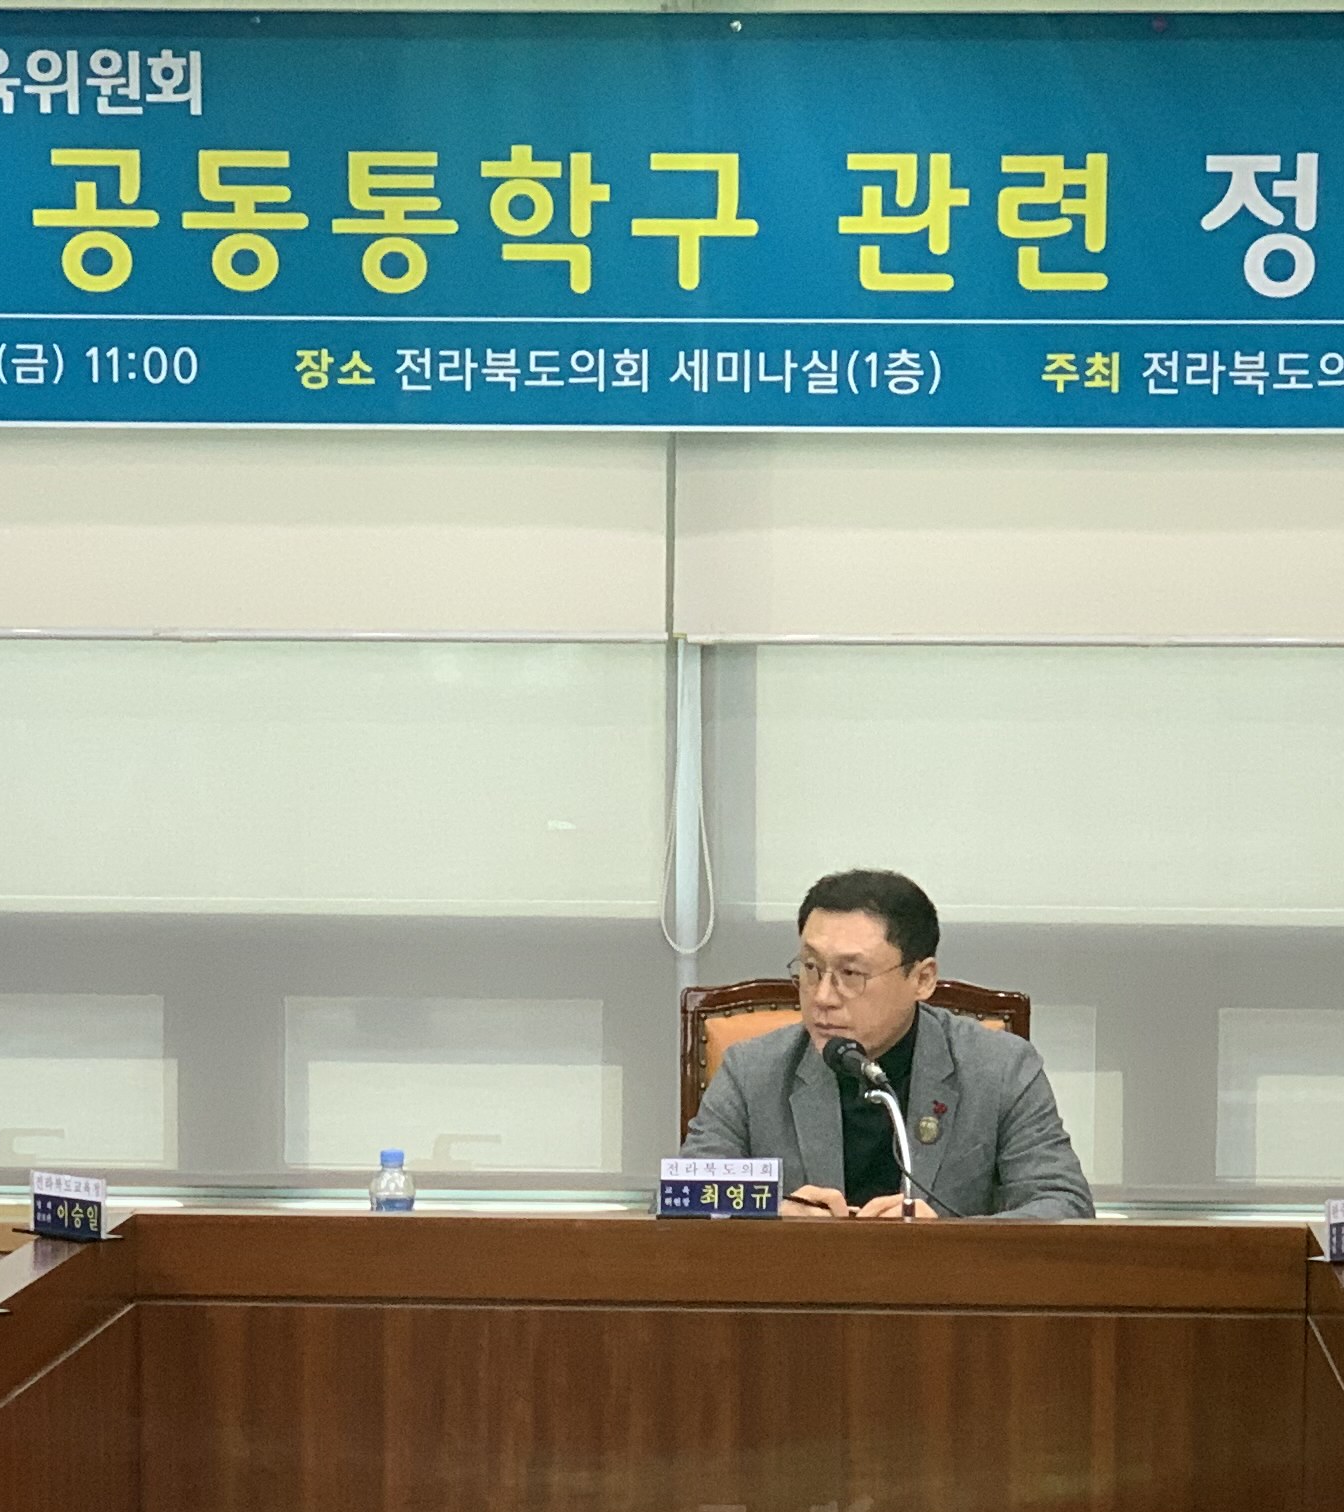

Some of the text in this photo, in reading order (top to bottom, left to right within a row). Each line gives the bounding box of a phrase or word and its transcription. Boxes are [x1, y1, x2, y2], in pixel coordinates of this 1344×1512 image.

[33, 145, 758, 294] 공동통학구
[838, 152, 1109, 292] 관련
[85, 346, 198, 384] 11:00
[295, 348, 942, 395] 장소 전라북도의회 세미나실(1층)
[1042, 352, 1119, 393] 주최
[666, 1161, 773, 1178] 전라북도의회
[57, 1200, 98, 1231] 이승일
[699, 1183, 772, 1210] 최영규
